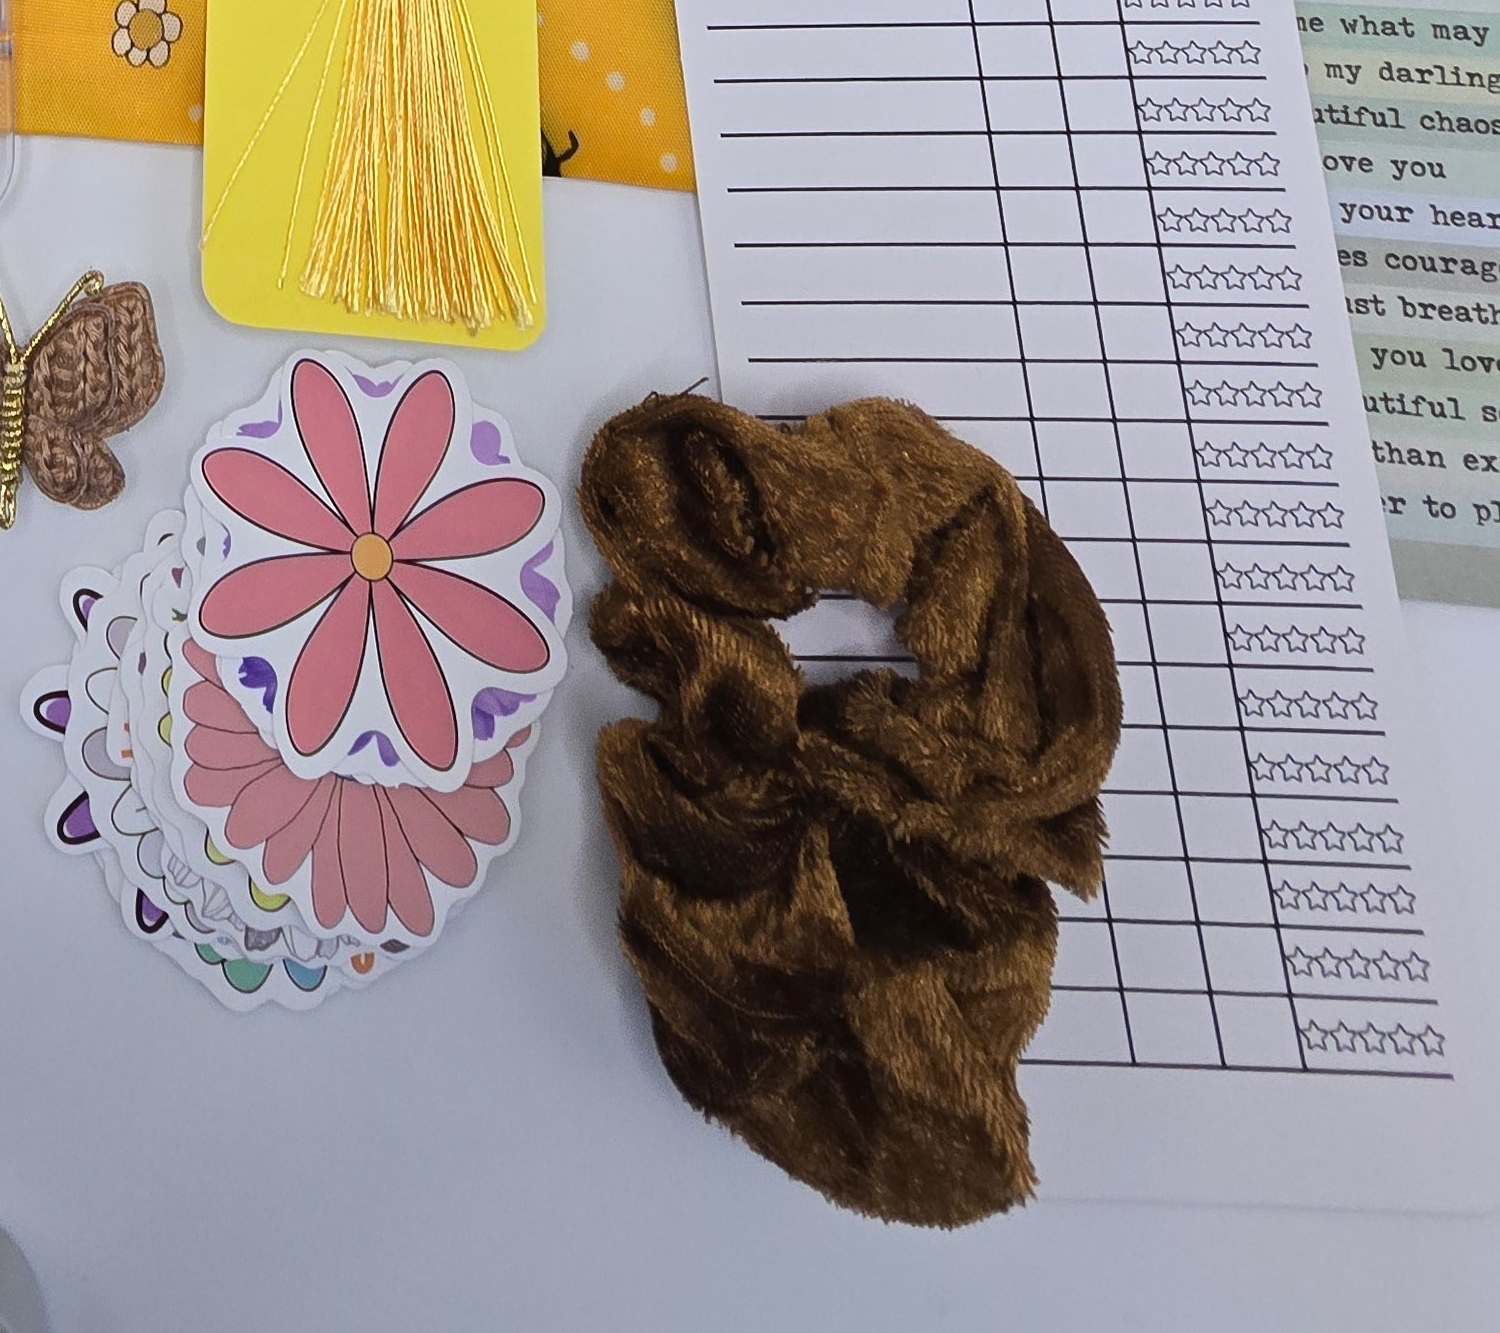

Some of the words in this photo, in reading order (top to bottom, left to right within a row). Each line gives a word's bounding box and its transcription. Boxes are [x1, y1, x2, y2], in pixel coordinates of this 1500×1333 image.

[1340, 15, 1415, 38] what
[1431, 24, 1489, 47] may
[1324, 63, 1361, 85] my
[1390, 160, 1446, 180] you
[1339, 203, 1414, 224] your
[1371, 348, 1427, 370] you
